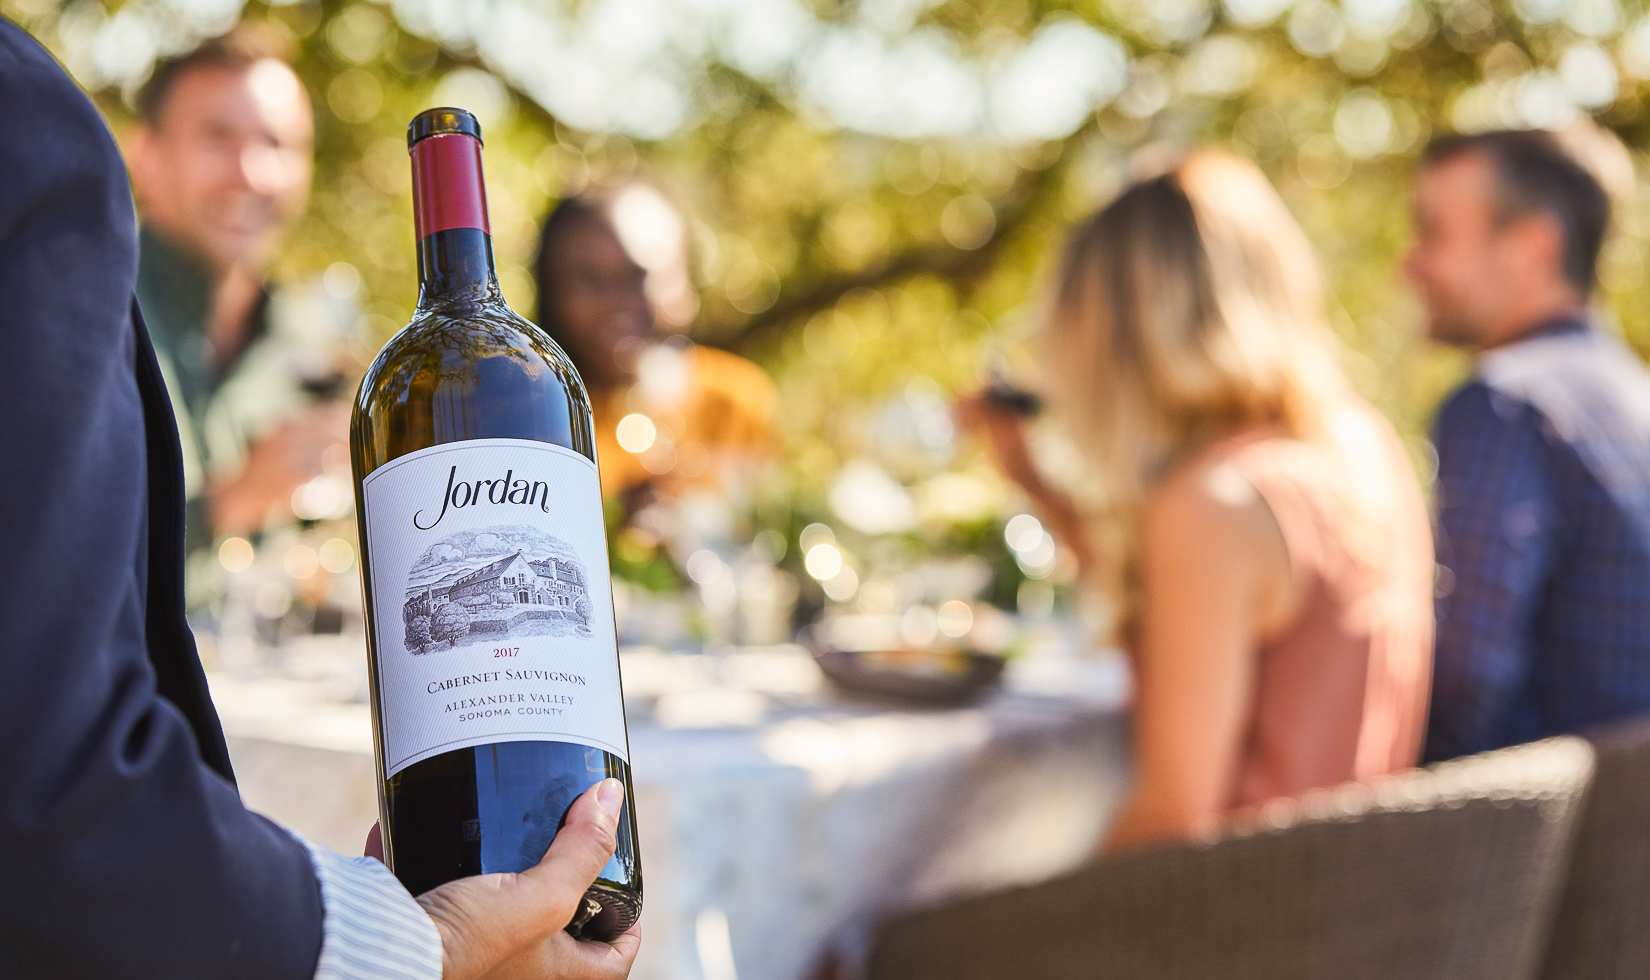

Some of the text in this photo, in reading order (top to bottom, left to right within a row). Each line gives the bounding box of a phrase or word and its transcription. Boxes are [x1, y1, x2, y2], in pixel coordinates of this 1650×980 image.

[413, 466, 549, 530] Jordan
[493, 647, 520, 658] 2017
[427, 669, 586, 694] CABERNET SAUVIGNON
[444, 693, 574, 713] ALEXANDER VALLEY
[459, 707, 563, 722] SONOMA COUNTY
